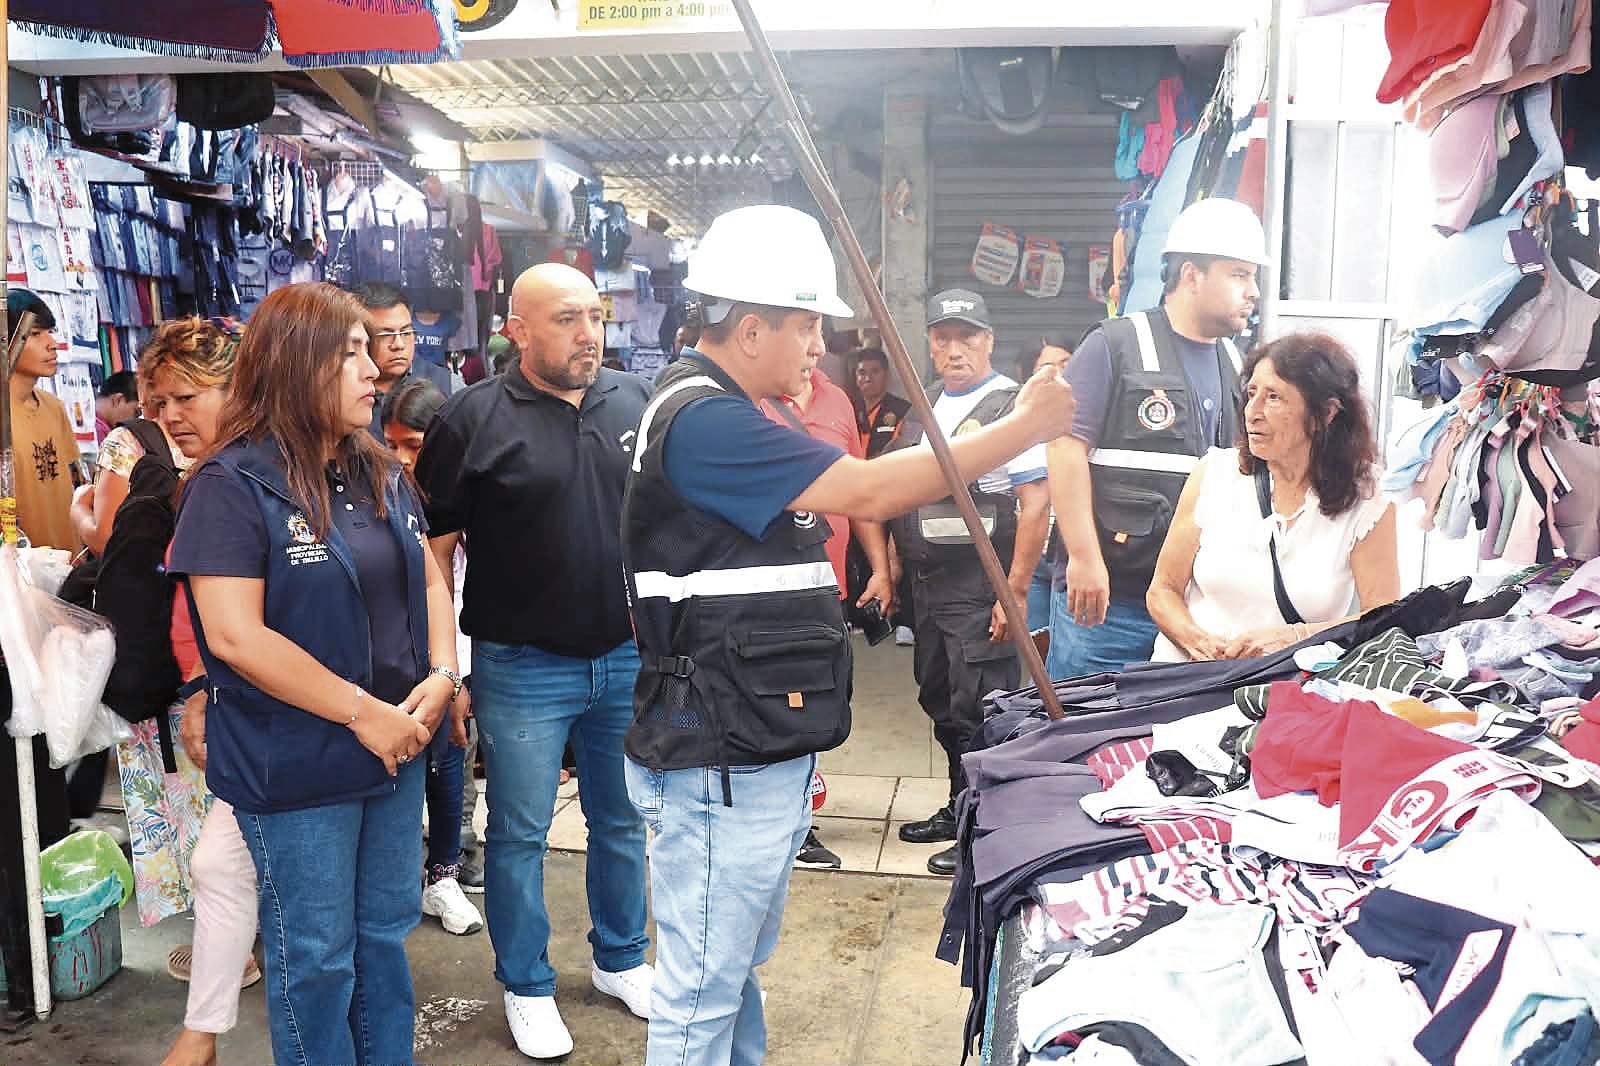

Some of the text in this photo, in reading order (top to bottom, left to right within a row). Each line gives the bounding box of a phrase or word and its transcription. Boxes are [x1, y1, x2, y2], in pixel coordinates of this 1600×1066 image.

[589, 6, 605, 19] DE
[609, 5, 637, 19] 2:00
[641, 7, 661, 20] pm
[665, 6, 673, 17] a
[677, 3, 705, 16] 4:00
